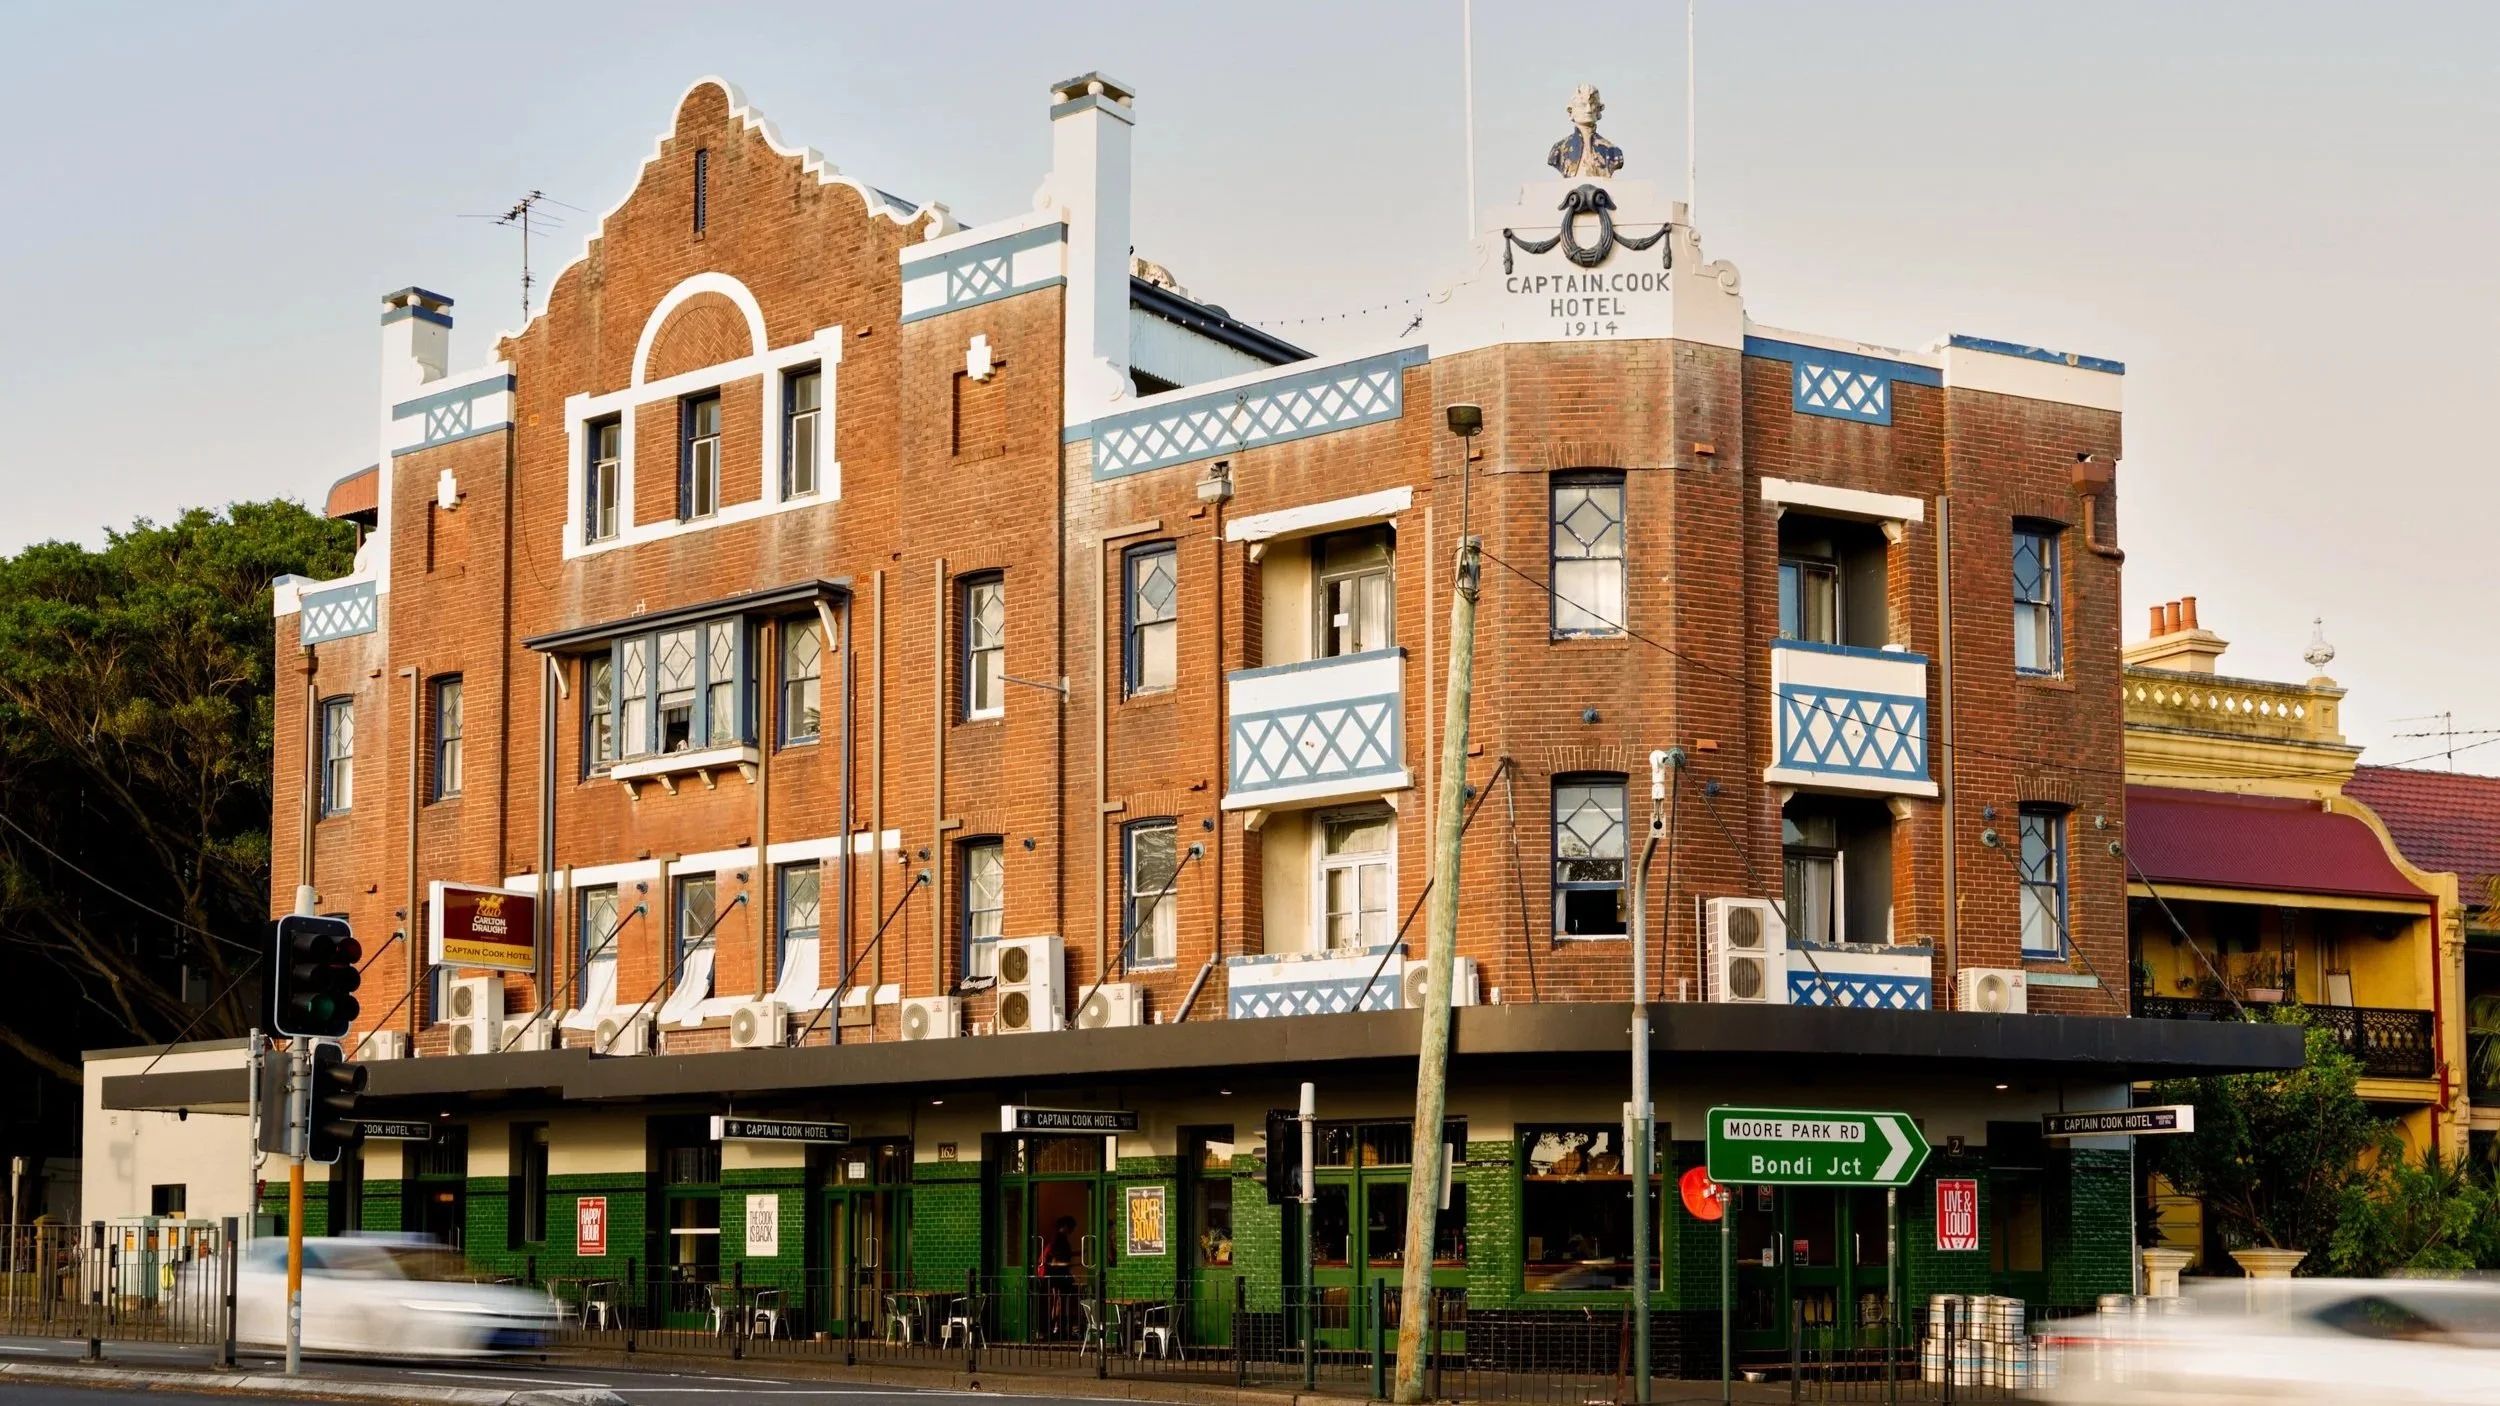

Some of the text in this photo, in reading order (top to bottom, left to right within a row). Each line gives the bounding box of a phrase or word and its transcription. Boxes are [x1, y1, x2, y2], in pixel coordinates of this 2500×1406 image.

[1550, 297, 1626, 317] HOTEL
[1564, 320, 1618, 337] 1914
[471, 923, 508, 935] DRAUGHT
[473, 915, 506, 926] CARLTON
[445, 945, 532, 960] CAPTAIN COOK HOTEL
[1037, 1113, 1070, 1126] CAPTAIN
[1072, 1113, 1093, 1126] COOK
[1094, 1114, 1118, 1127] HOTEL
[2064, 1114, 2153, 1131] CAPTAIN COOK HOTEL
[385, 1125, 410, 1135] HOTEL
[746, 1124, 780, 1136] CAPTAIN
[782, 1125, 803, 1137] COOK
[804, 1126, 829, 1138] HOTEL
[1730, 1121, 1860, 1139] MOORE PARK RD
[940, 1146, 955, 1159] 162
[1952, 1139, 1960, 1153] 2
[1751, 1155, 1862, 1176] Bondi Jct
[581, 1207, 602, 1225] HAPPY
[1131, 1198, 1160, 1220] SUPER
[1134, 1219, 1160, 1242] BOWL
[1945, 1212, 1971, 1236] LOUD
[582, 1224, 600, 1242] HOUR
